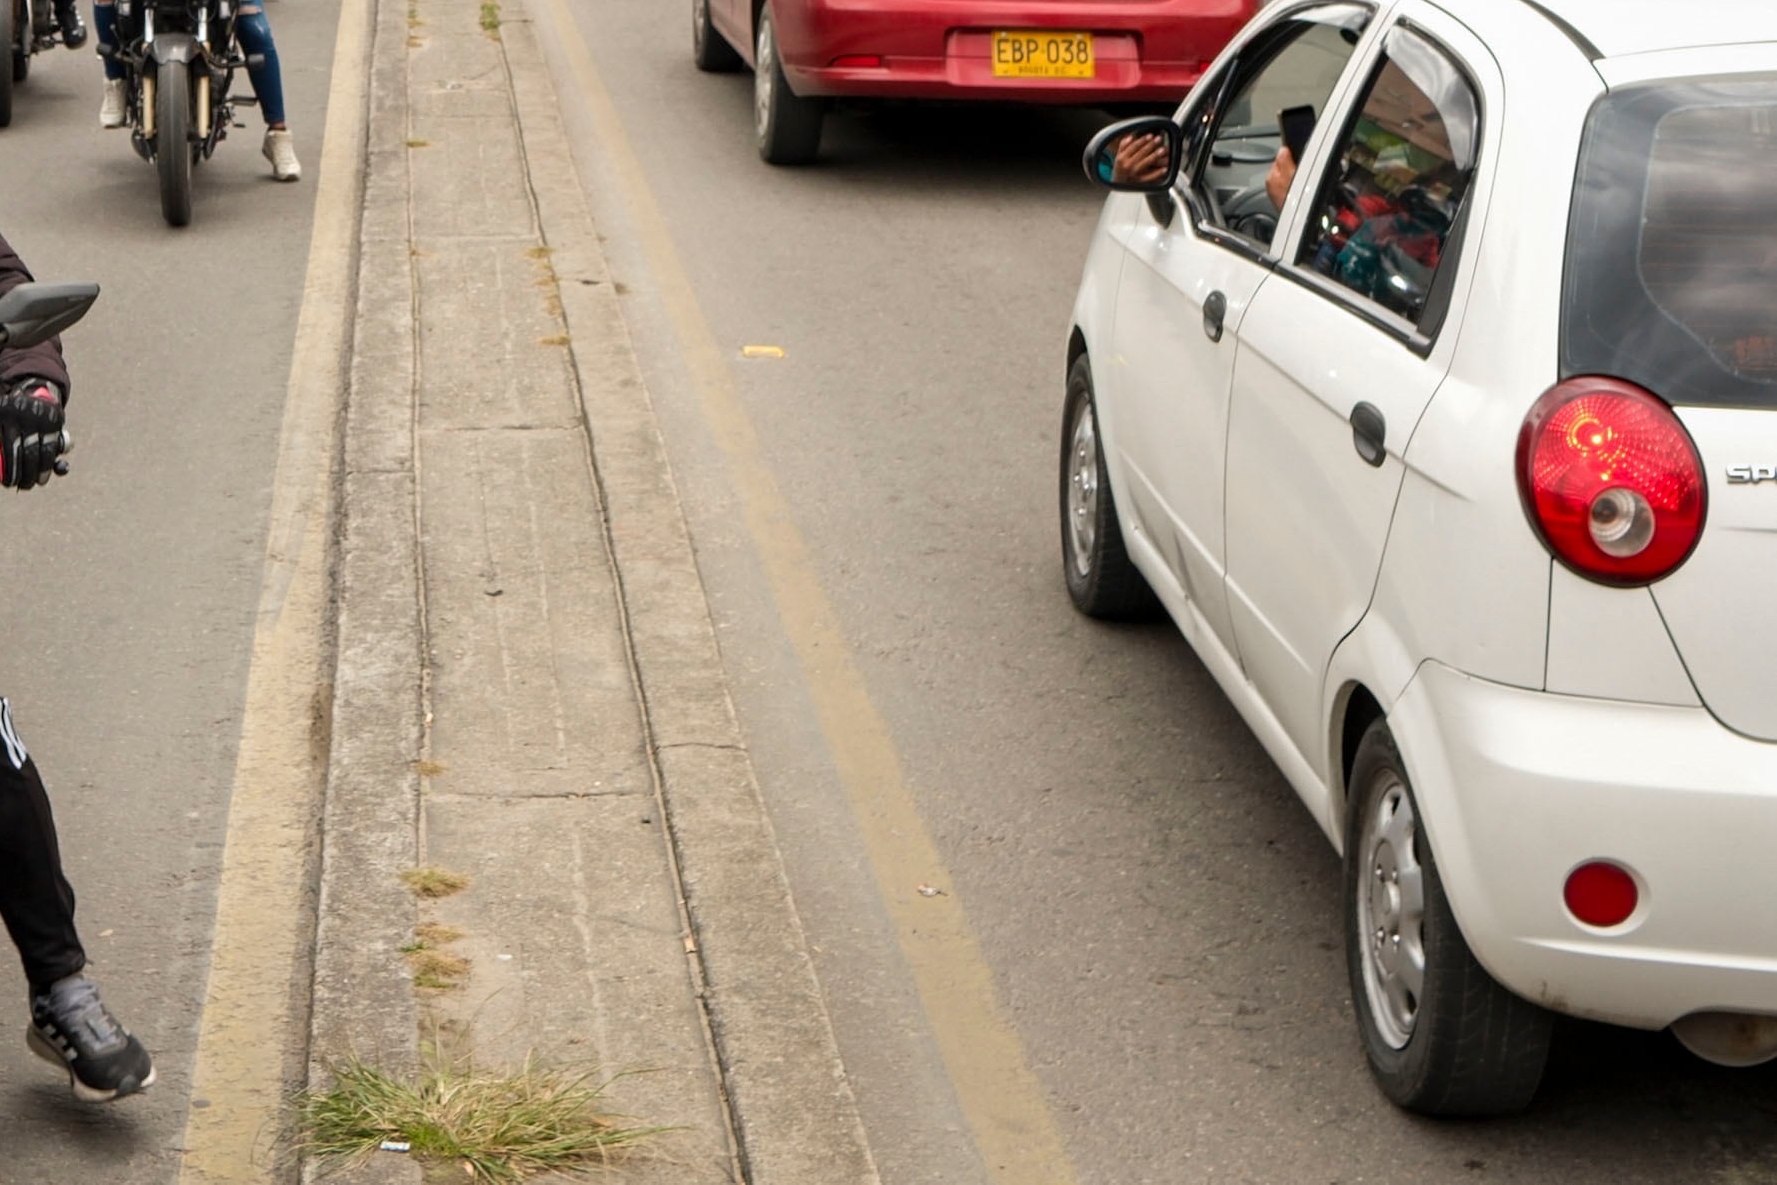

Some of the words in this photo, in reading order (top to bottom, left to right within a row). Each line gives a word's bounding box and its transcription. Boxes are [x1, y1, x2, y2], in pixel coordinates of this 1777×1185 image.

[996, 38, 1039, 64] EBP
[1046, 38, 1089, 65] 038
[1725, 463, 1777, 485] SP
